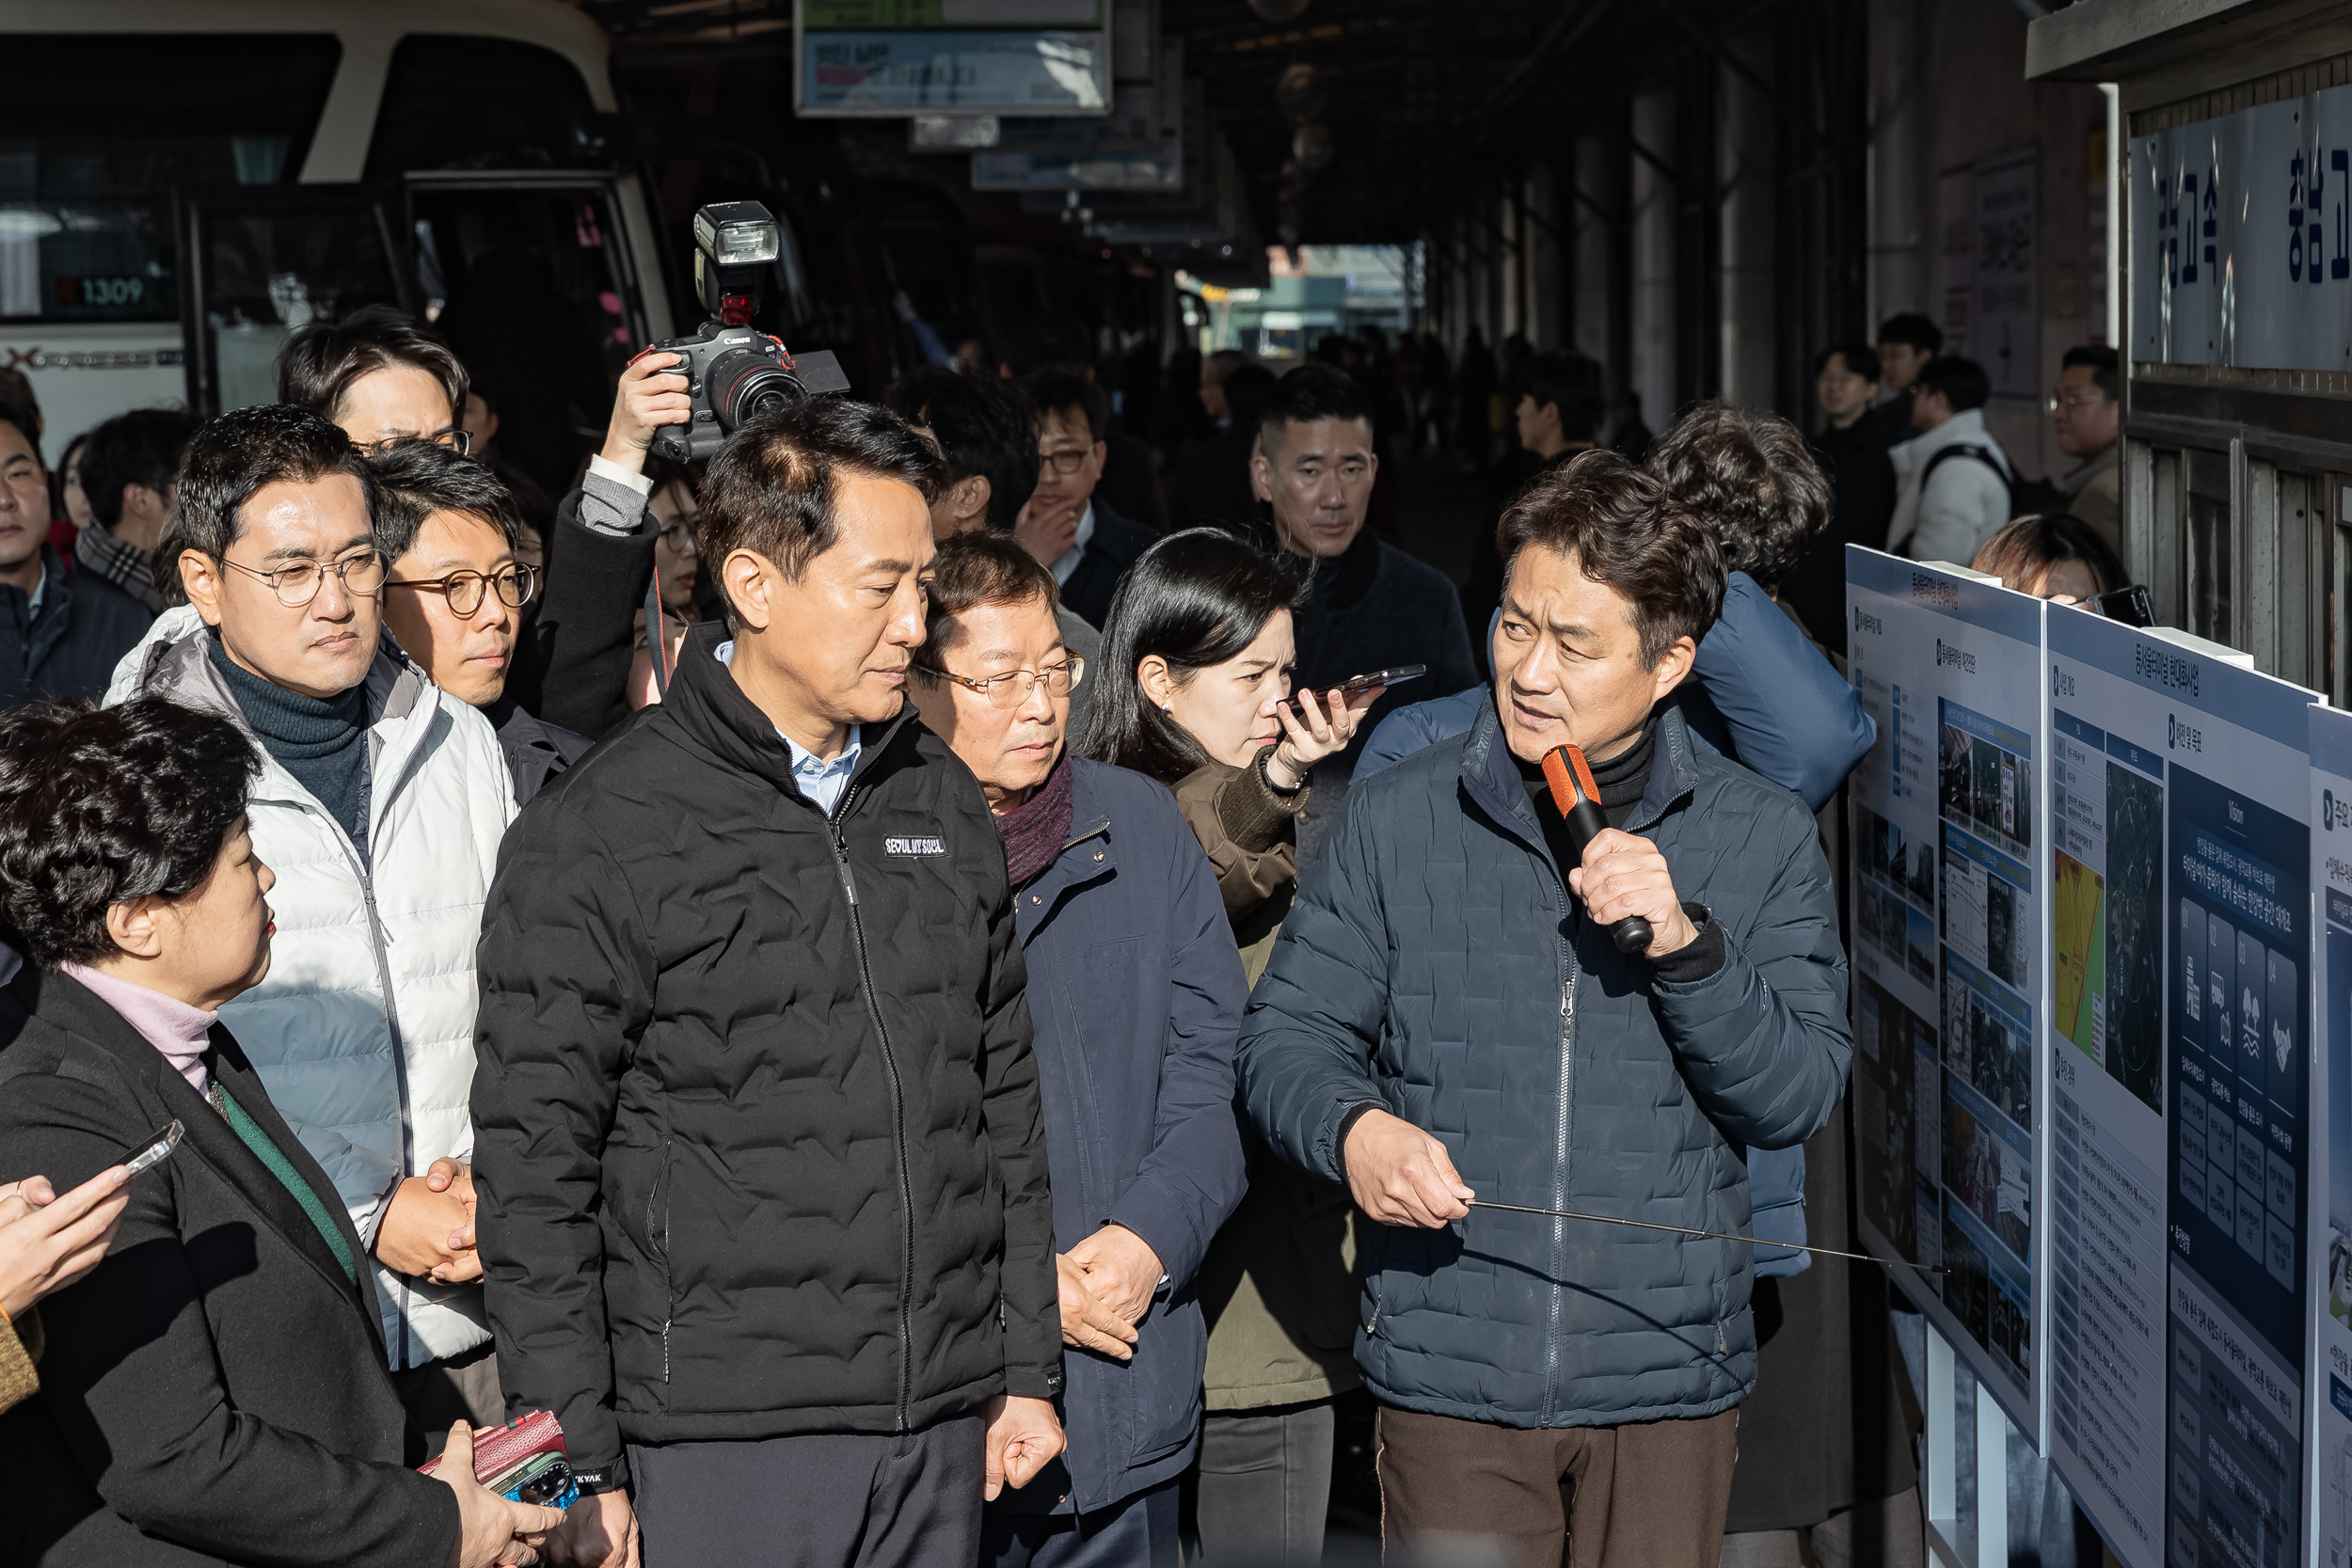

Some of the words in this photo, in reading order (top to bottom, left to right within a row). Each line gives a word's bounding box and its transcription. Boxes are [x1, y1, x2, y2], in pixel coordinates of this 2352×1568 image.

[723, 336, 751, 345] Canon
[575, 533, 601, 543] KYAK
[2136, 644, 2169, 686] 동서울터미널
[2169, 657, 2199, 698] 현대화사업
[2176, 722, 2185, 749] 비전
[2191, 728, 2201, 753] 목표
[2228, 799, 2243, 826] Vision
[2334, 800, 2349, 830] 주요
[2233, 879, 2247, 910] 숨쉬는
[2248, 888, 2263, 919] 한강변
